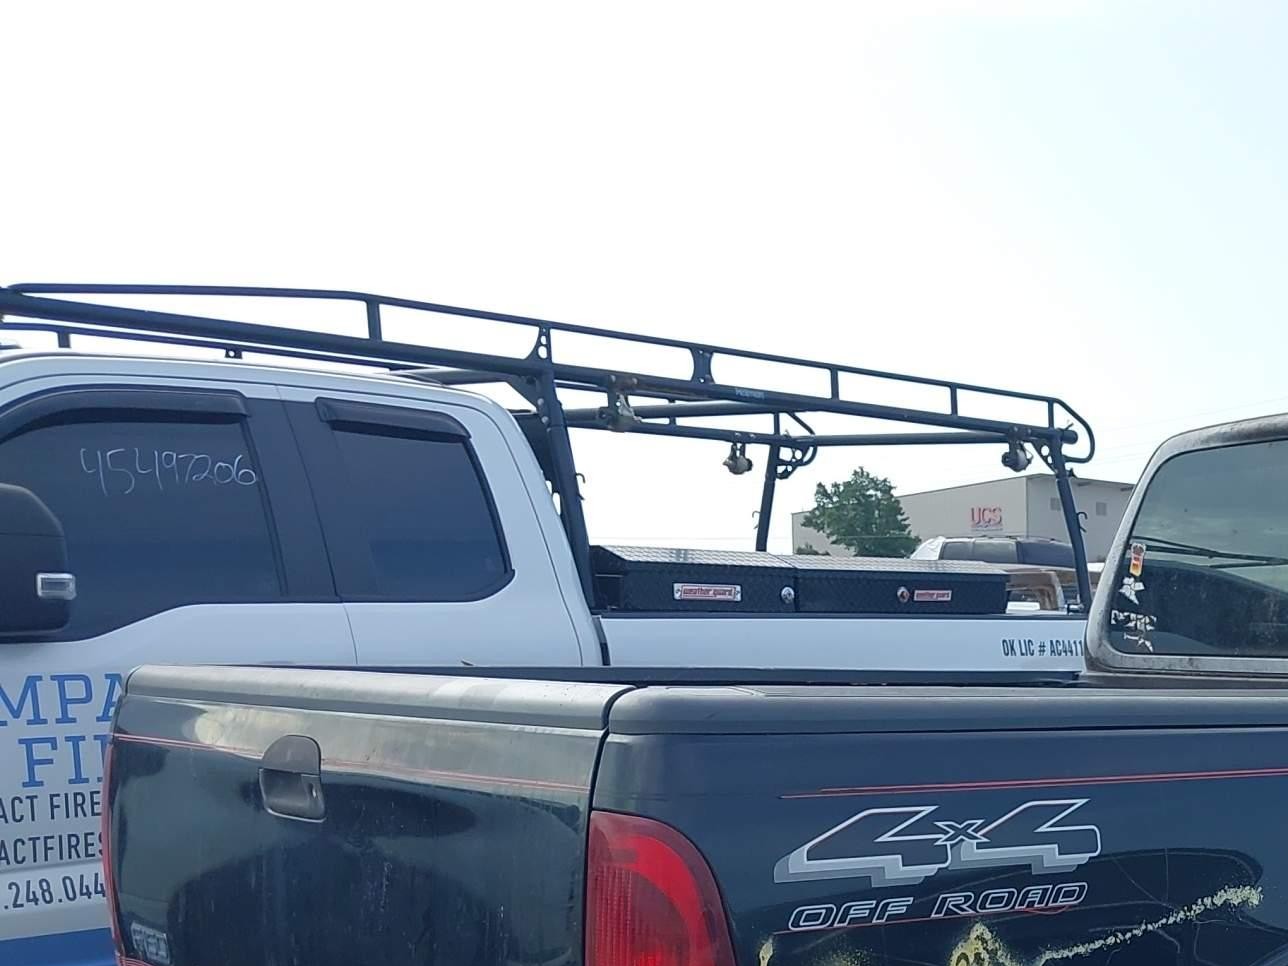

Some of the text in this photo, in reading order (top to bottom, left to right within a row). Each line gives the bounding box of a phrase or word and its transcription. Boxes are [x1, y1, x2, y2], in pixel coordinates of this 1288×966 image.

[970, 507, 1002, 525] UCS
[1002, 639, 1017, 656] OK
[1019, 639, 1035, 656] LIC
[1038, 641, 1046, 656] #
[774, 798, 1101, 888] 4x4
[788, 882, 1089, 931] OFF ROAD
